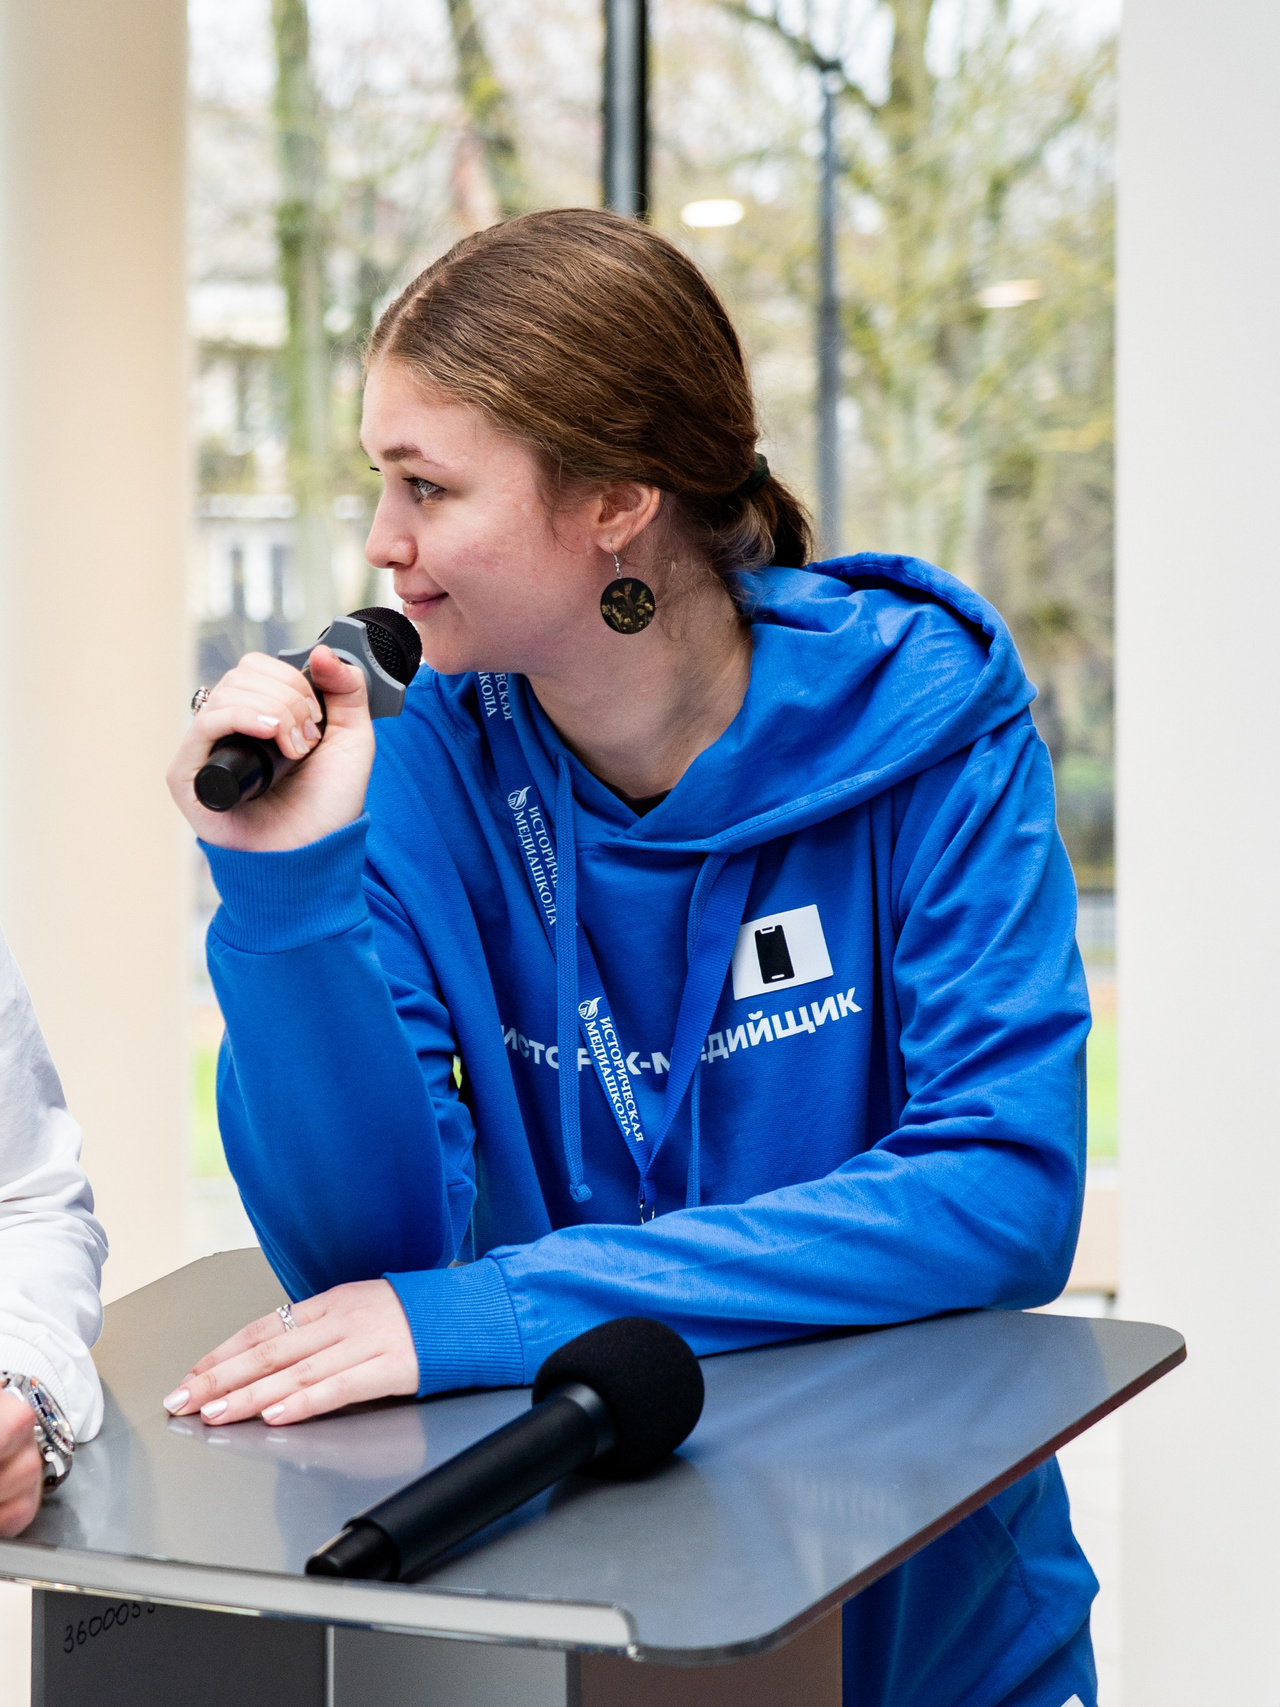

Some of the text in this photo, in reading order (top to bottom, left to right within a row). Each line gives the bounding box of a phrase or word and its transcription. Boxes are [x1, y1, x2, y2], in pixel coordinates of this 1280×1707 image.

[514, 811, 558, 926] МЕДИАШКОЛА
[585, 1021, 631, 1136] МЕДИАШКОЛА
[599, 1016, 644, 1142] ИСТОРИЧЕСКАЯ
